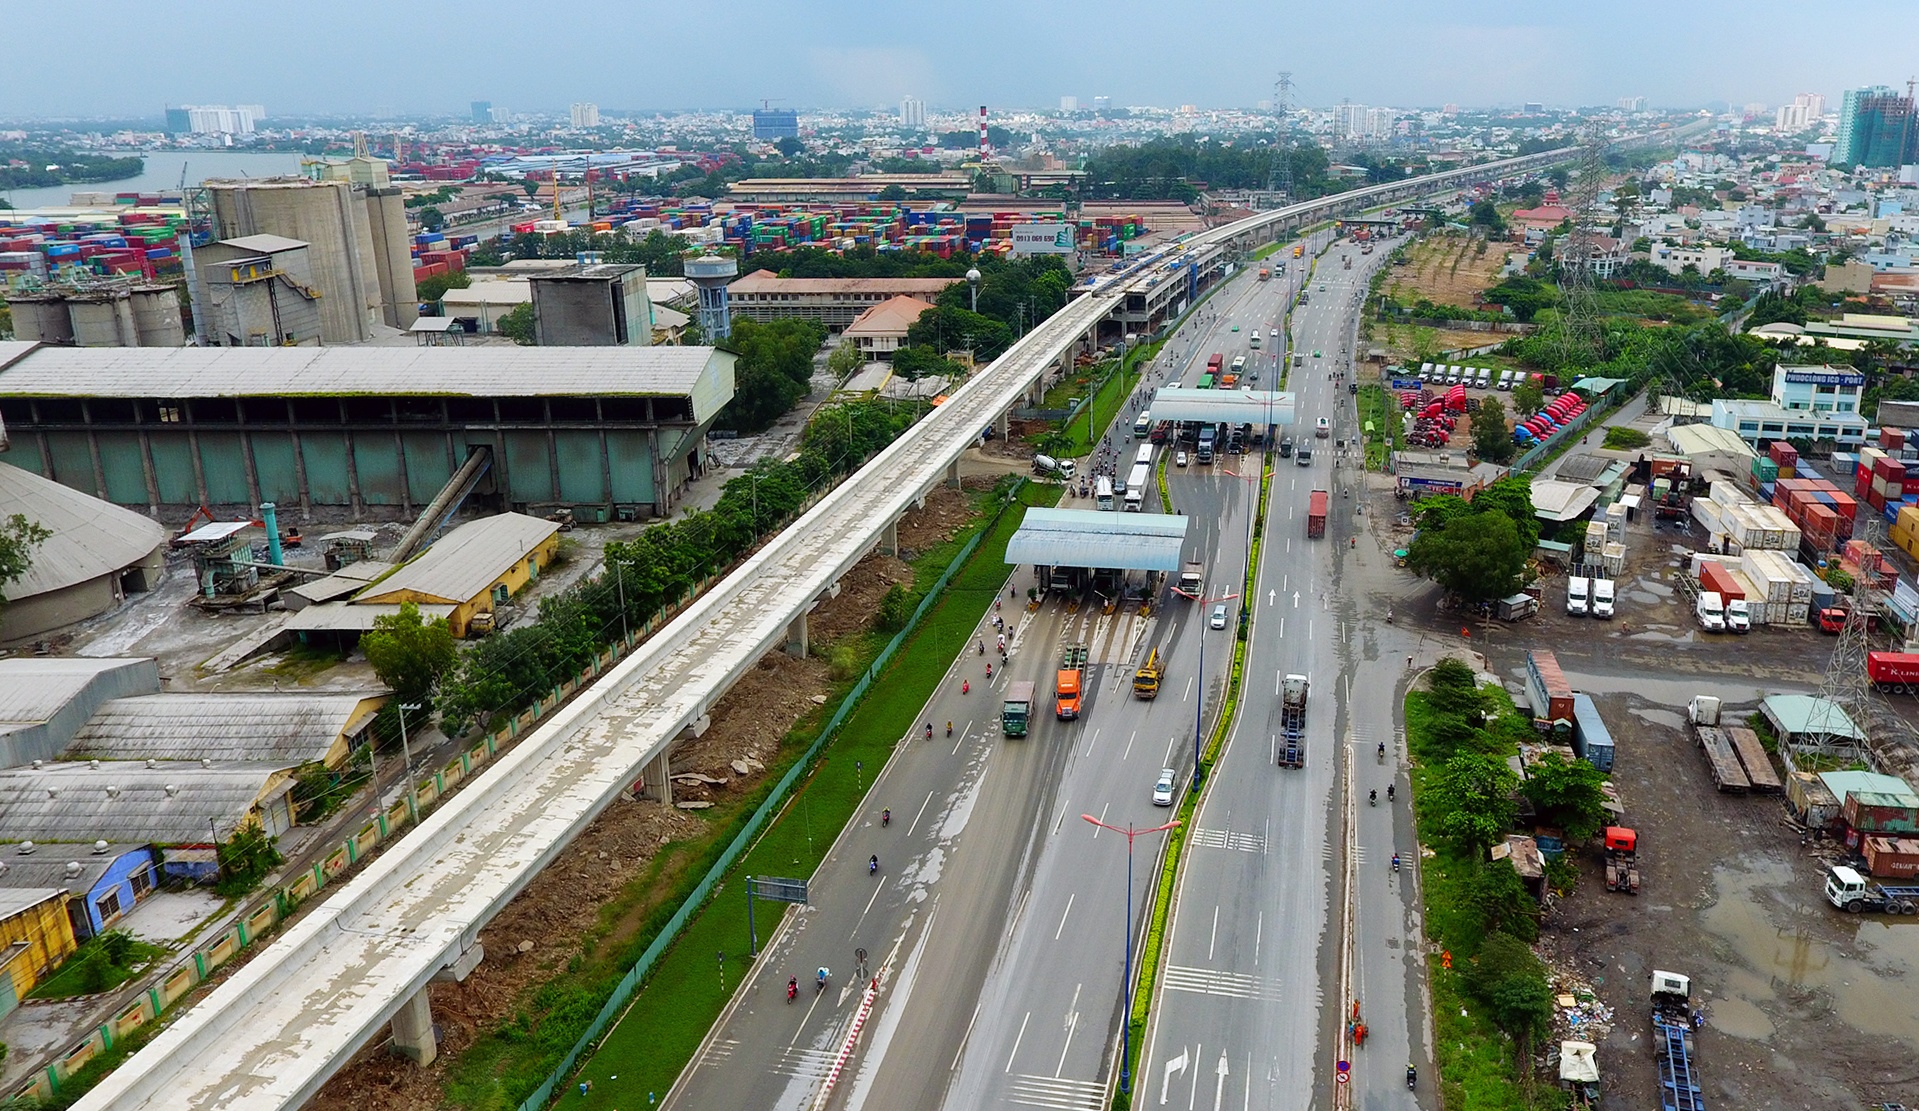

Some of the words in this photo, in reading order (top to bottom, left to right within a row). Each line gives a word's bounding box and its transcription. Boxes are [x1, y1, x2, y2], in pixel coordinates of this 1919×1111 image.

[1786, 373, 1826, 383] PHUOCLONG
[1827, 375, 1840, 383] ICD
[1844, 376, 1863, 384] PORT
